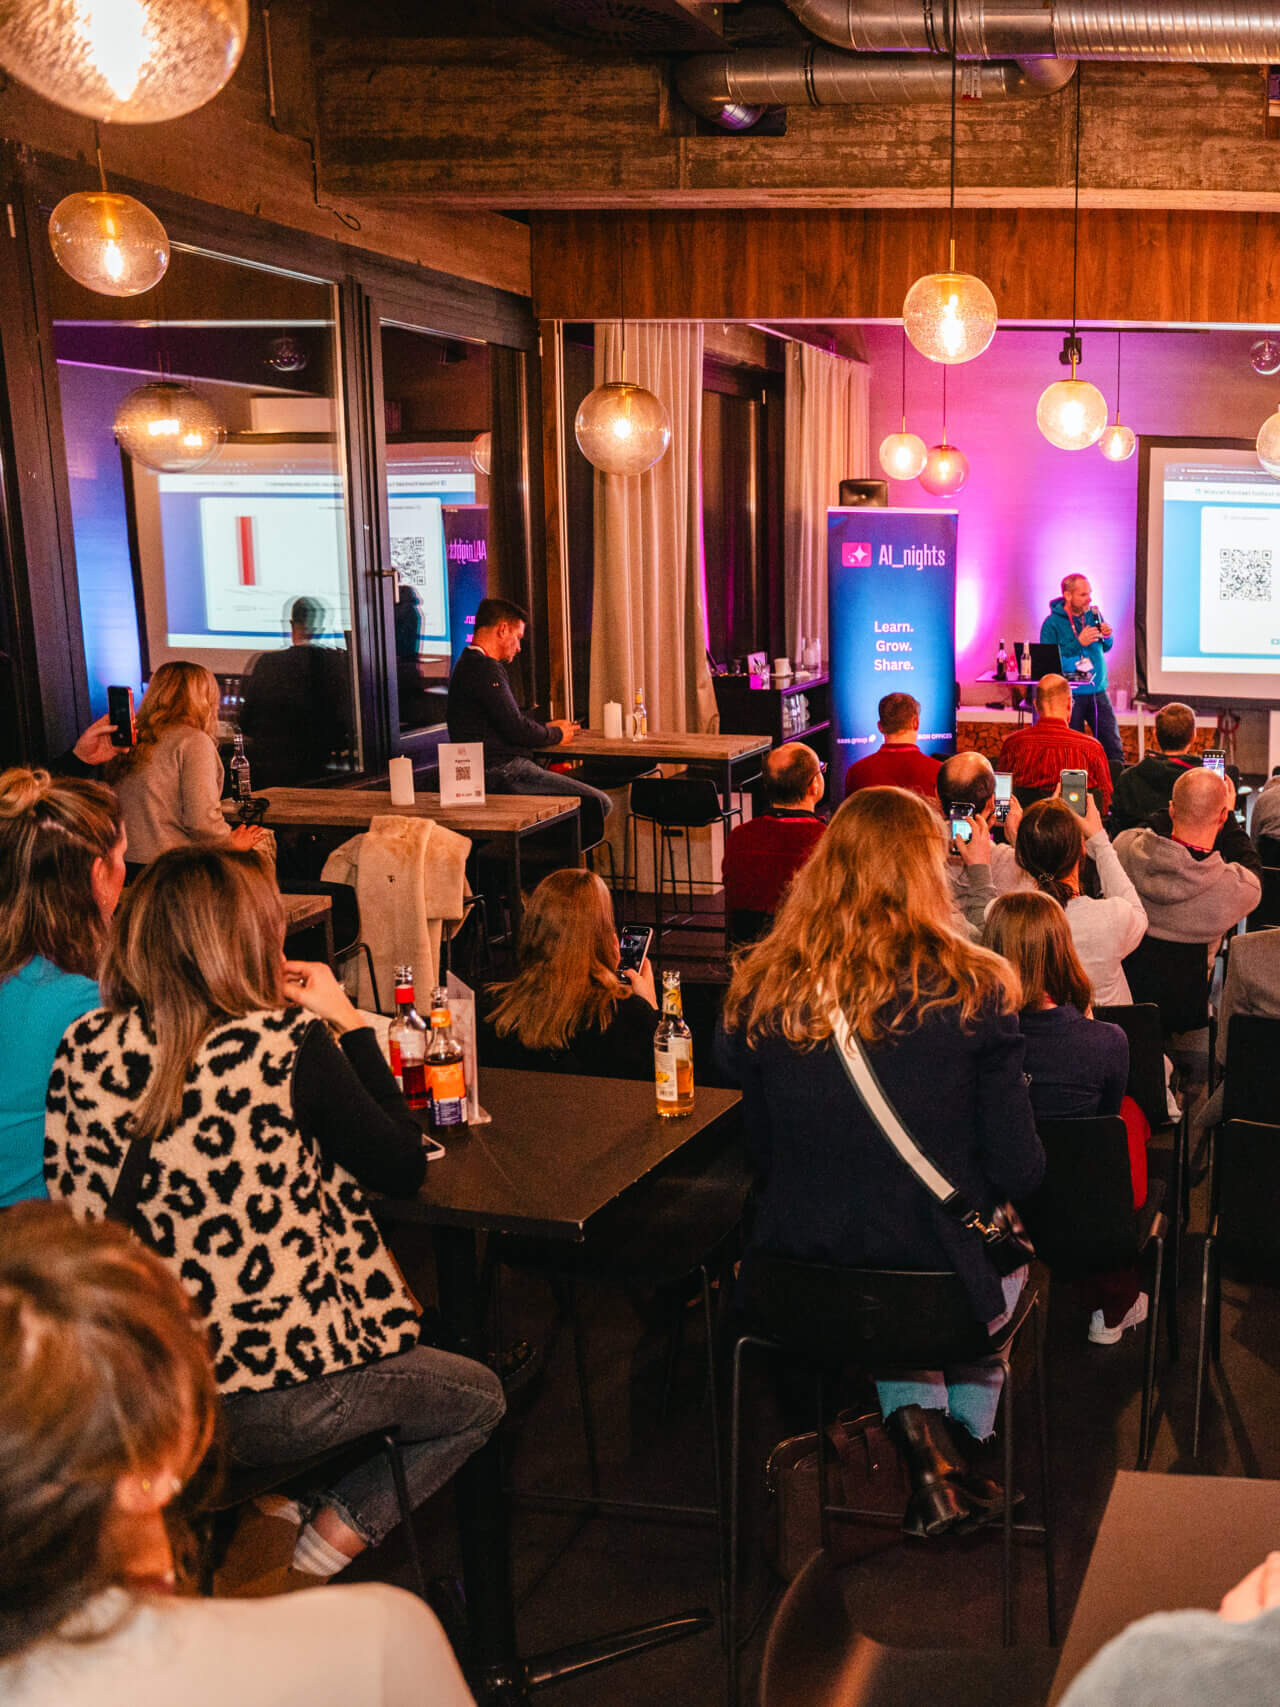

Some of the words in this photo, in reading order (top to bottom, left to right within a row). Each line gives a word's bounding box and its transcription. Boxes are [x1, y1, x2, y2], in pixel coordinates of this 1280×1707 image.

[878, 544, 946, 571] AI_nights
[874, 621, 914, 633] Learn.
[875, 640, 913, 652] Grow.
[874, 659, 915, 671] Share.
